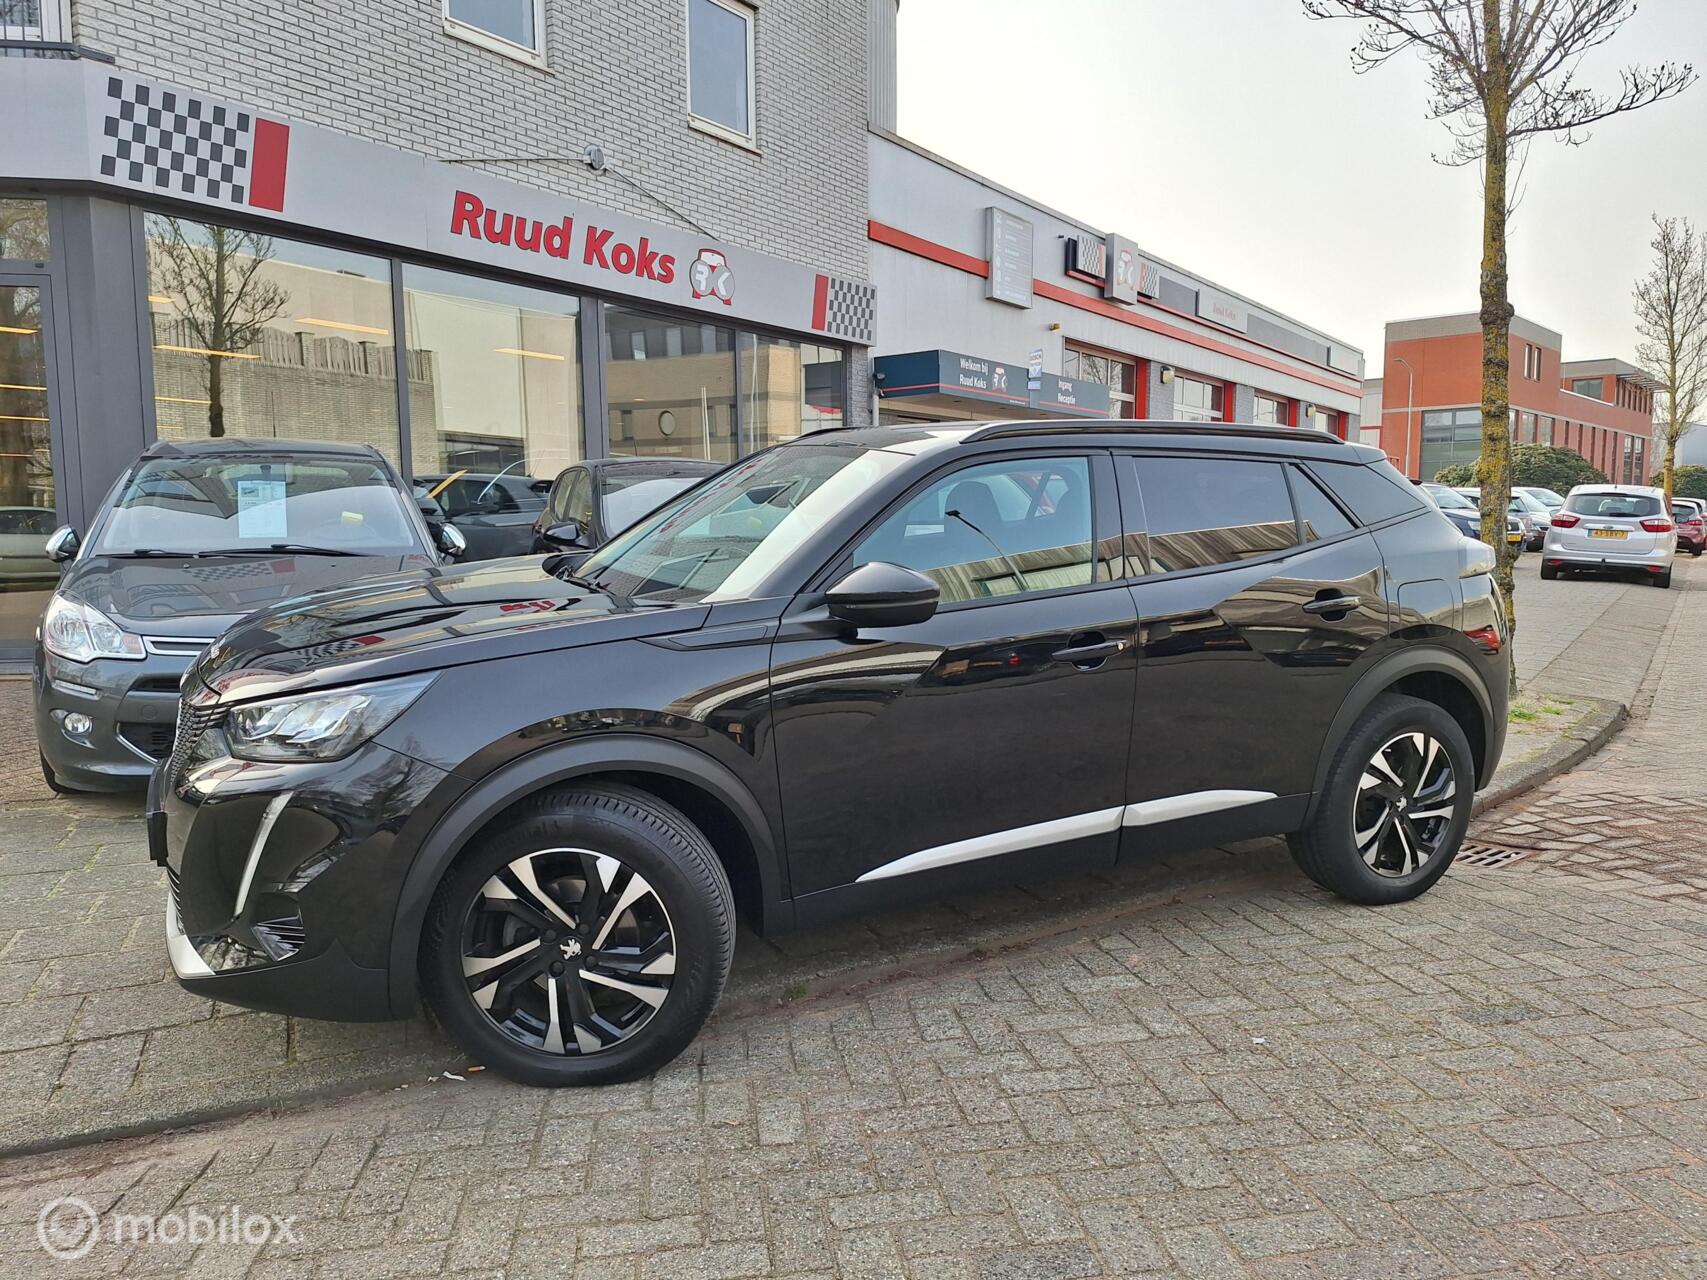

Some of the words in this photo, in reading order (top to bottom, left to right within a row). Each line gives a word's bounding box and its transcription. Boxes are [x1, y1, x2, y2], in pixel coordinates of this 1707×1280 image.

[451, 190, 573, 260] Ruud
[583, 225, 676, 284] Koks
[959, 357, 981, 371] Welkom
[981, 361, 989, 376] bij
[959, 374, 974, 387] Ruud
[974, 376, 987, 389] Koks
